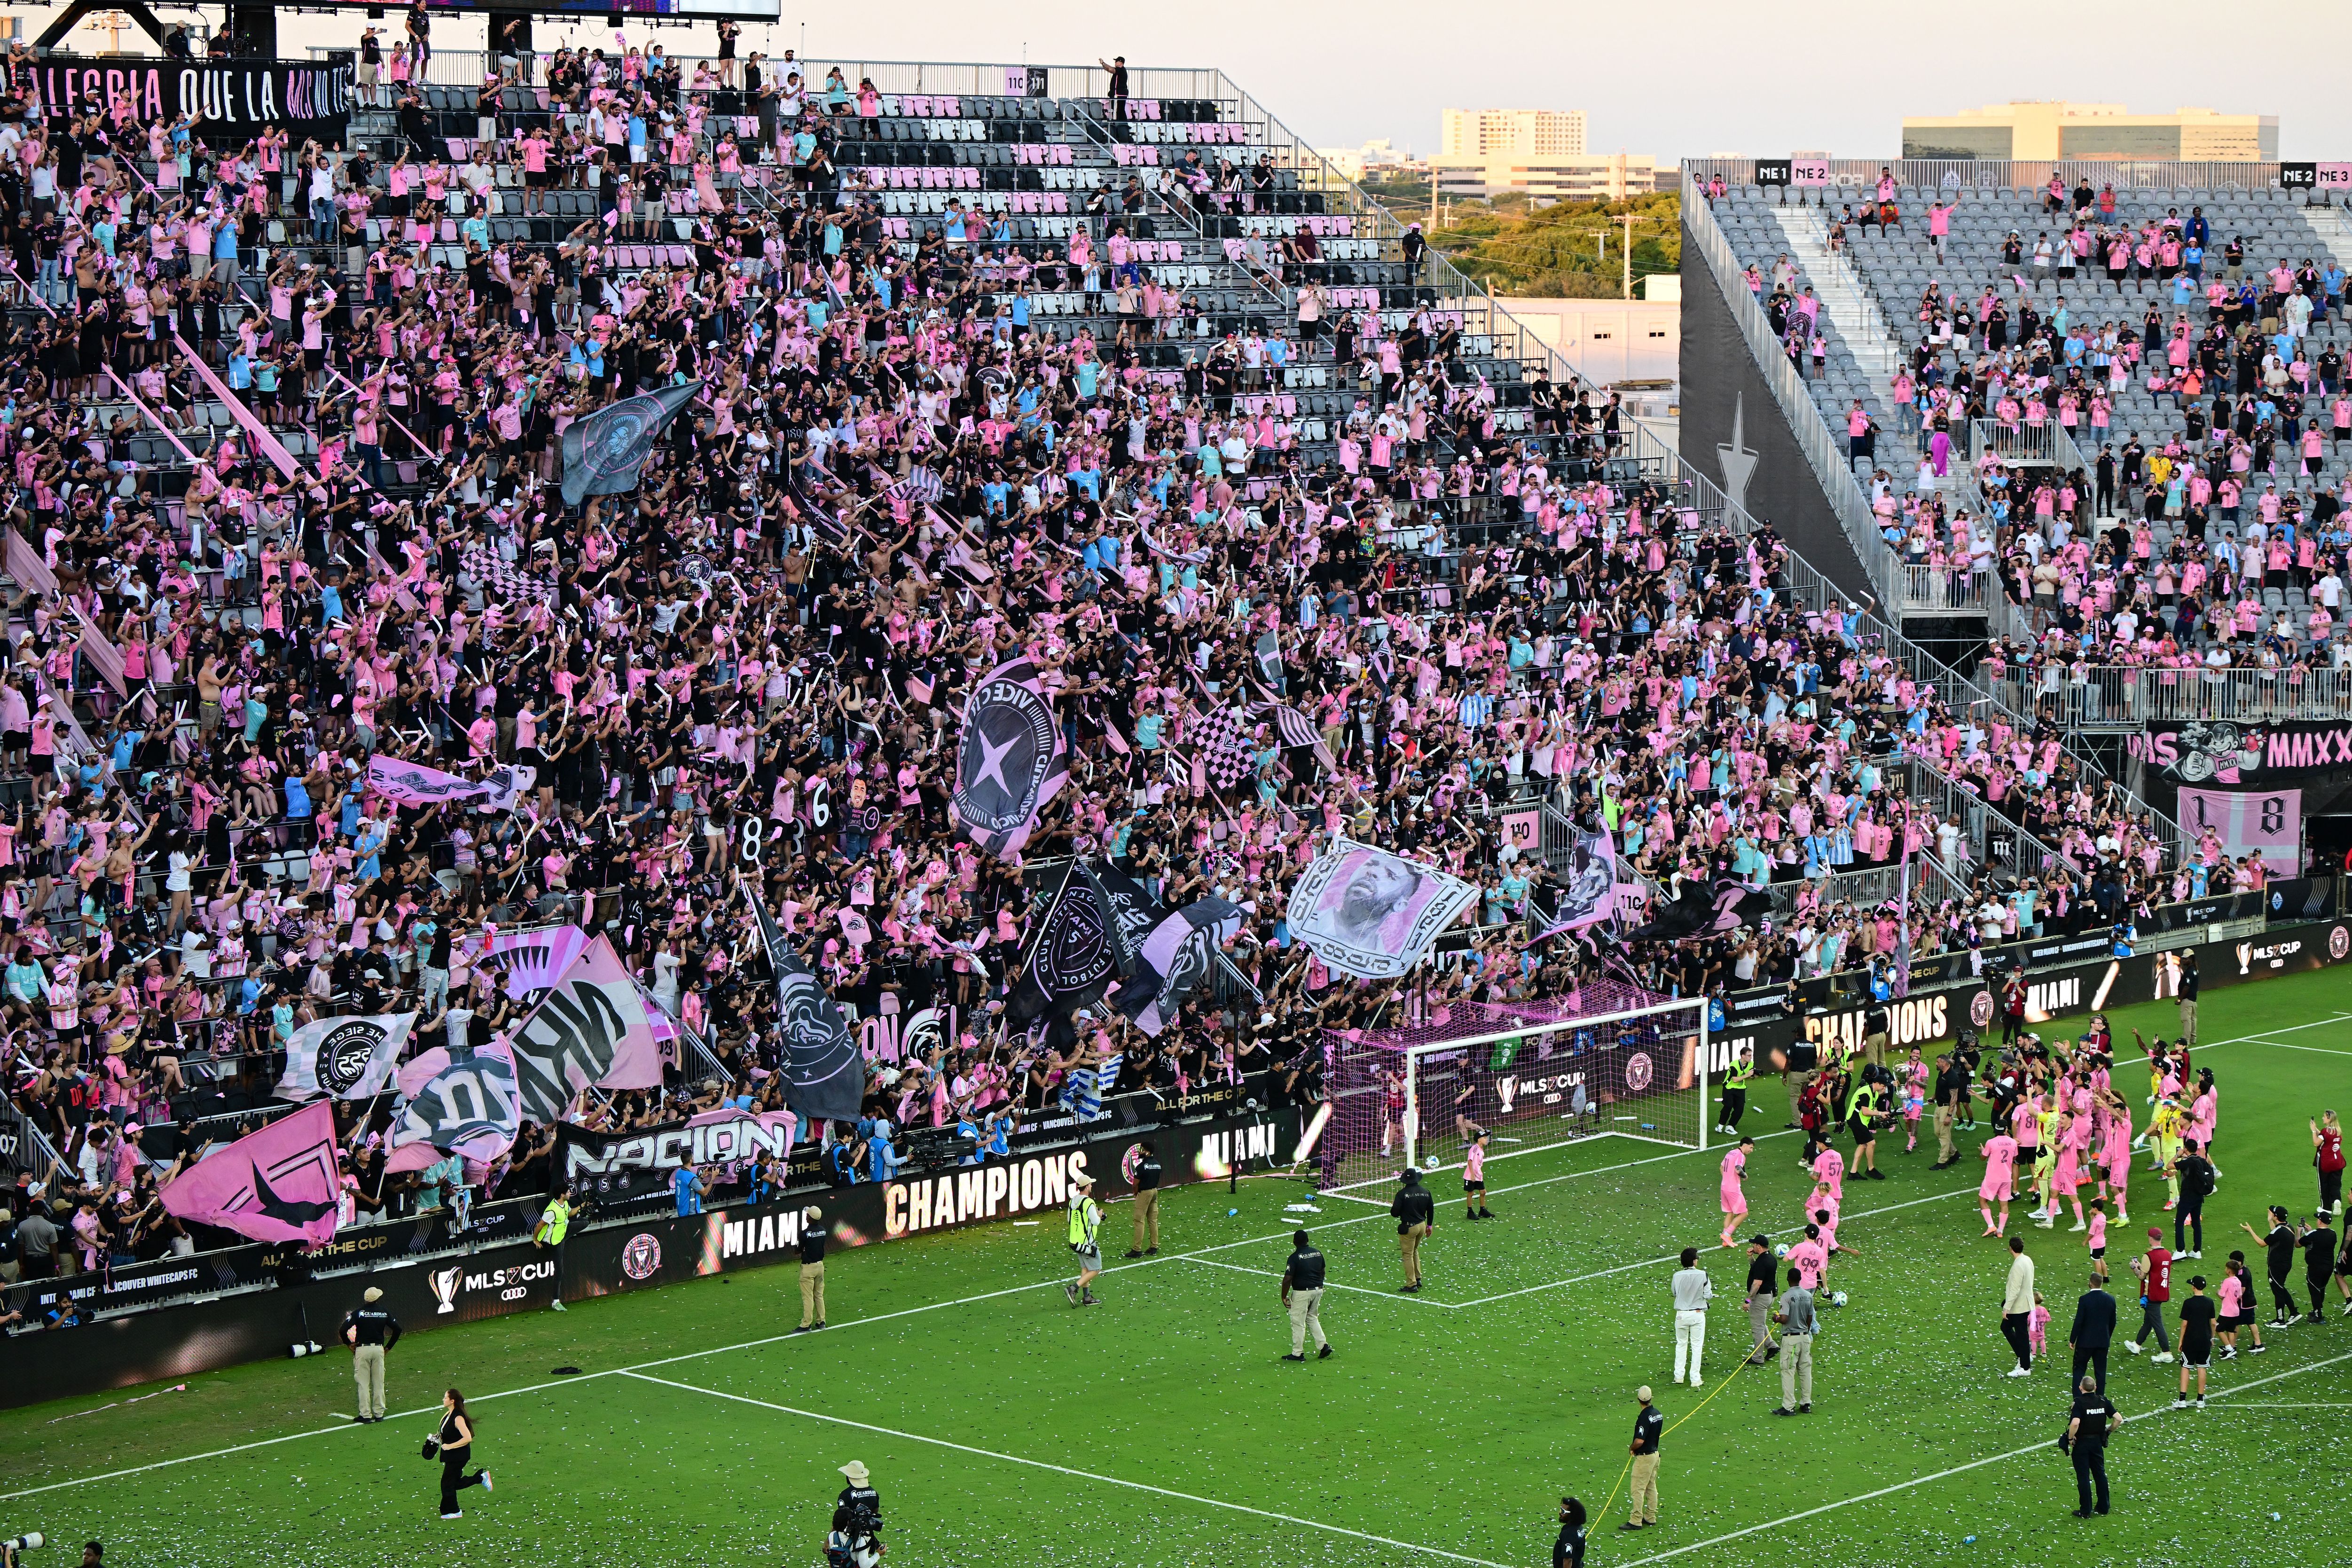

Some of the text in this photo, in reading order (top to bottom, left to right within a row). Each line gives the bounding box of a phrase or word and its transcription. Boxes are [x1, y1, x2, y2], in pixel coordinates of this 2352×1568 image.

[606, 68, 620, 80] 09
[1009, 78, 1023, 89] 110
[1031, 78, 1044, 89] 111
[246, 71, 279, 121] LA
[287, 70, 313, 119] MLS
[315, 71, 330, 118] NO
[333, 66, 349, 113] TE
[1760, 168, 1787, 179] NE 1
[1796, 168, 1825, 179] NE 2
[2284, 171, 2313, 182] NE 2
[2320, 171, 2348, 181] NE 3
[787, 429, 804, 438] 1896
[1891, 774, 1904, 788] 111
[813, 780, 830, 827] 6
[869, 811, 877, 826] 4
[2259, 796, 2287, 836] 8
[1511, 822, 1529, 839] 110
[743, 816, 762, 861] 8
[1993, 841, 2009, 855] 111
[1621, 895, 1641, 910] 110
[2062, 942, 2083, 952] VANCOUVER
[2083, 939, 2103, 949] WHITECAPS
[2254, 941, 2301, 960] MLS CUP
[1040, 939, 1051, 973] CLUB
[1908, 966, 1939, 979] THE CUP
[2027, 978, 2079, 1011] MIAMI
[1735, 996, 1782, 1011] VANCOUVER WHITECAPS
[1321, 1071, 1335, 1080] CUP
[1521, 1072, 1585, 1096] MLS CUP
[1155, 1098, 1176, 1111] ALL
[1202, 1091, 1225, 1104] THE
[1225, 1087, 1246, 1100] CP
[1031, 1123, 1037, 1132] CF
[1102, 1110, 1112, 1121] FC
[2025, 1115, 2038, 1129] 81
[1202, 1123, 1275, 1165] MIAMI
[2001, 1149, 2008, 1163] 2
[795, 1161, 821, 1174] THE
[1723, 1158, 1729, 1173] 11
[1828, 1162, 1842, 1177] 57
[885, 1151, 1088, 1235] CHAMPIONS
[486, 1215, 504, 1224] CUP
[325, 1241, 356, 1255] THE
[358, 1236, 387, 1251] CUP
[1801, 1257, 1819, 1272] 99
[86, 1287, 96, 1298] CF
[148, 1271, 188, 1290] WHITECAPS
[188, 1269, 198, 1279] FC
[465, 1270, 505, 1292] MLS
